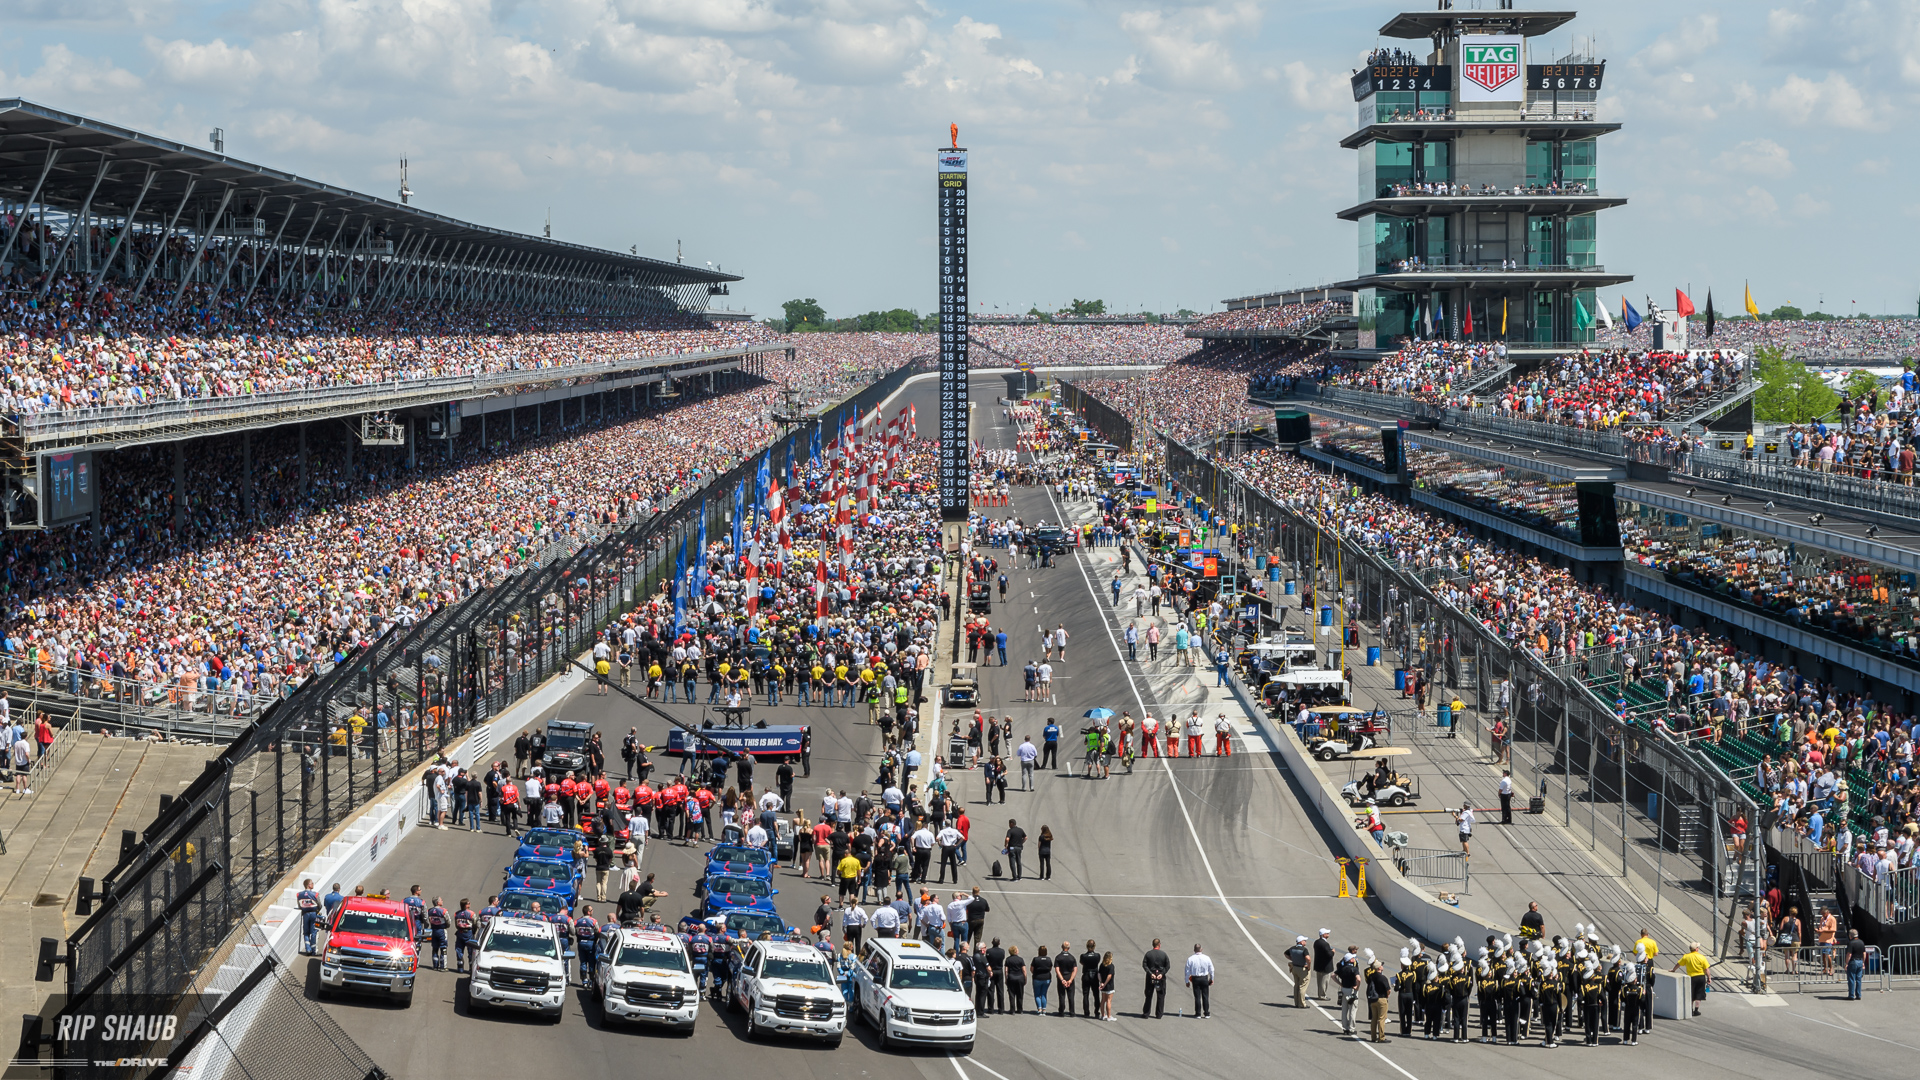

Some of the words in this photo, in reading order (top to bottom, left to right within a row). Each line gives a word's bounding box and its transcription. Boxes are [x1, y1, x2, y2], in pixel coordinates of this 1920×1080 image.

[1469, 48, 1513, 62] TAG
[1374, 66, 1388, 77] 20
[1390, 66, 1403, 77] 22
[1408, 66, 1418, 77] 12
[1432, 66, 1435, 76] 1
[1543, 66, 1552, 76] 18
[1554, 66, 1568, 76] 21
[1574, 66, 1584, 76] 13
[1594, 66, 1600, 76] 3
[1468, 66, 1515, 87] HEUER
[1378, 80, 1384, 90] 1
[1392, 79, 1400, 90] 2
[1408, 79, 1416, 89] 3
[1423, 79, 1431, 89] 4
[1542, 78, 1550, 88] 5
[1558, 78, 1565, 88] 6
[1574, 78, 1581, 88] 7
[1589, 78, 1596, 88] 8
[944, 190, 948, 198] 1
[944, 198, 950, 206] 2
[944, 208, 950, 216] 3
[944, 218, 950, 226] 4
[944, 228, 950, 236] 5
[944, 238, 950, 246] 6
[944, 246, 950, 254] 7
[944, 256, 950, 264] 8
[944, 266, 950, 274] 9
[942, 276, 954, 284] 10
[944, 286, 952, 294] 11
[944, 294, 954, 304] 12
[944, 304, 954, 312] 13
[944, 314, 954, 322] 14
[944, 324, 954, 332] 15
[944, 334, 954, 342] 16
[944, 342, 954, 352] 17
[944, 352, 954, 360] 18
[944, 362, 954, 370] 19
[942, 372, 954, 380] 20
[944, 382, 954, 390] 21
[942, 392, 954, 400] 22
[942, 400, 954, 410] 23
[942, 410, 954, 420] 24
[942, 420, 954, 428] 25
[942, 430, 954, 438] 26
[942, 440, 954, 448] 27
[942, 450, 954, 458] 28
[942, 458, 954, 468] 29
[958, 458, 966, 466] 10
[942, 468, 954, 476] 30
[958, 468, 966, 476] 15
[944, 478, 954, 486] 31
[958, 478, 966, 486] 60
[942, 488, 954, 496] 32
[942, 498, 954, 506] 33
[1248, 608, 1256, 616] 21
[1273, 634, 1283, 642] 20
[767, 738, 783, 746] MAY.
[344, 910, 406, 922] CHEVROLET
[492, 930, 552, 940] CHEVROLET
[622, 943, 682, 954] CHEVROLET
[766, 955, 824, 964] CHEVROLET
